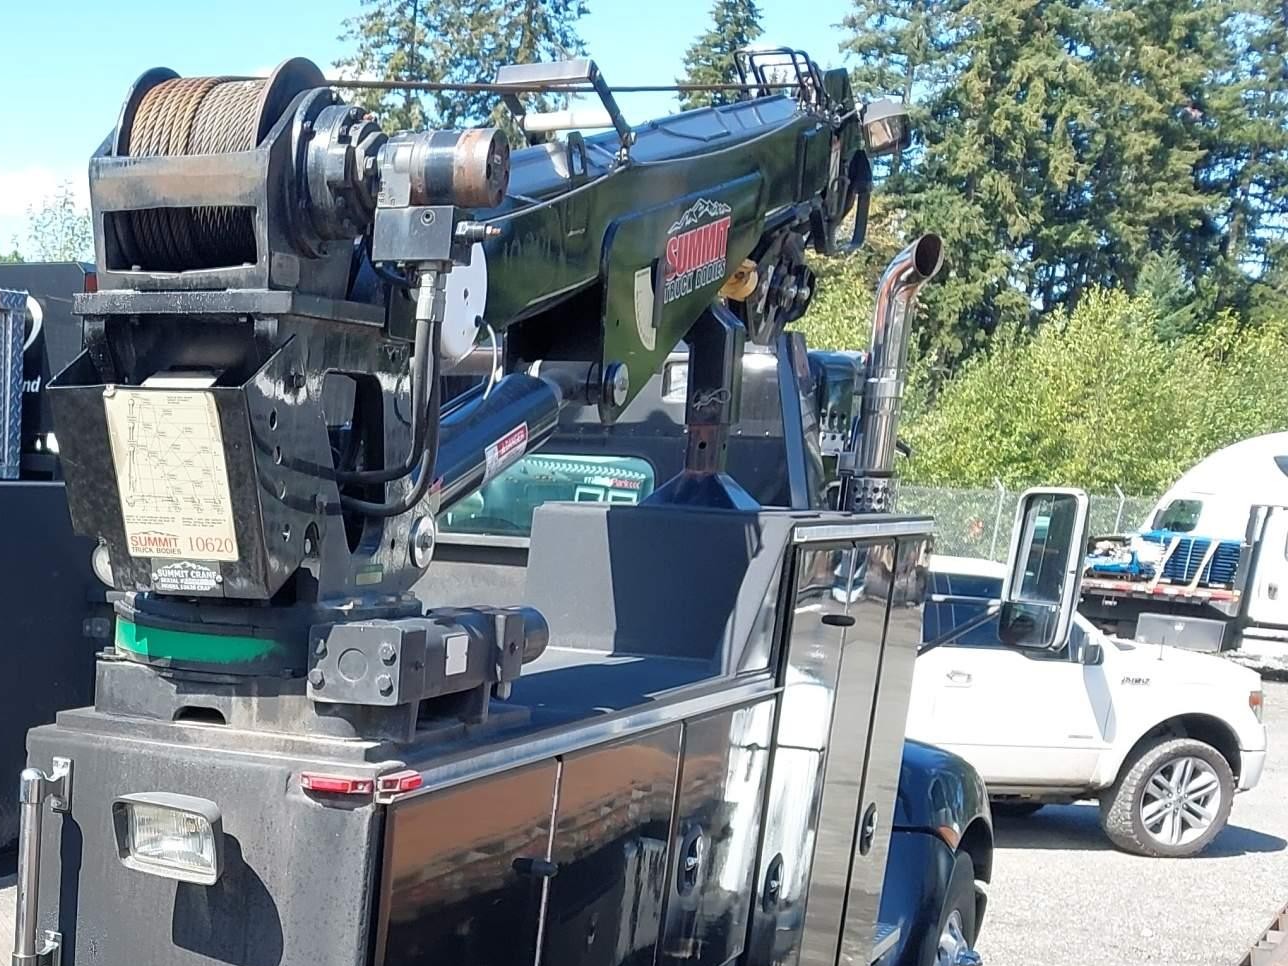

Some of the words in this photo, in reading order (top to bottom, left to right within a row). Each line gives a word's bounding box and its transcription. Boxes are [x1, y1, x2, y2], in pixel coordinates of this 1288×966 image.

[665, 215, 731, 282] SUMMIT
[664, 270, 695, 304] TRUCK
[694, 257, 727, 290] BODIES
[130, 535, 178, 548] SUMMIT
[189, 535, 234, 554] 10620
[156, 547, 182, 555] BODIES
[157, 568, 189, 578] SUMMIT
